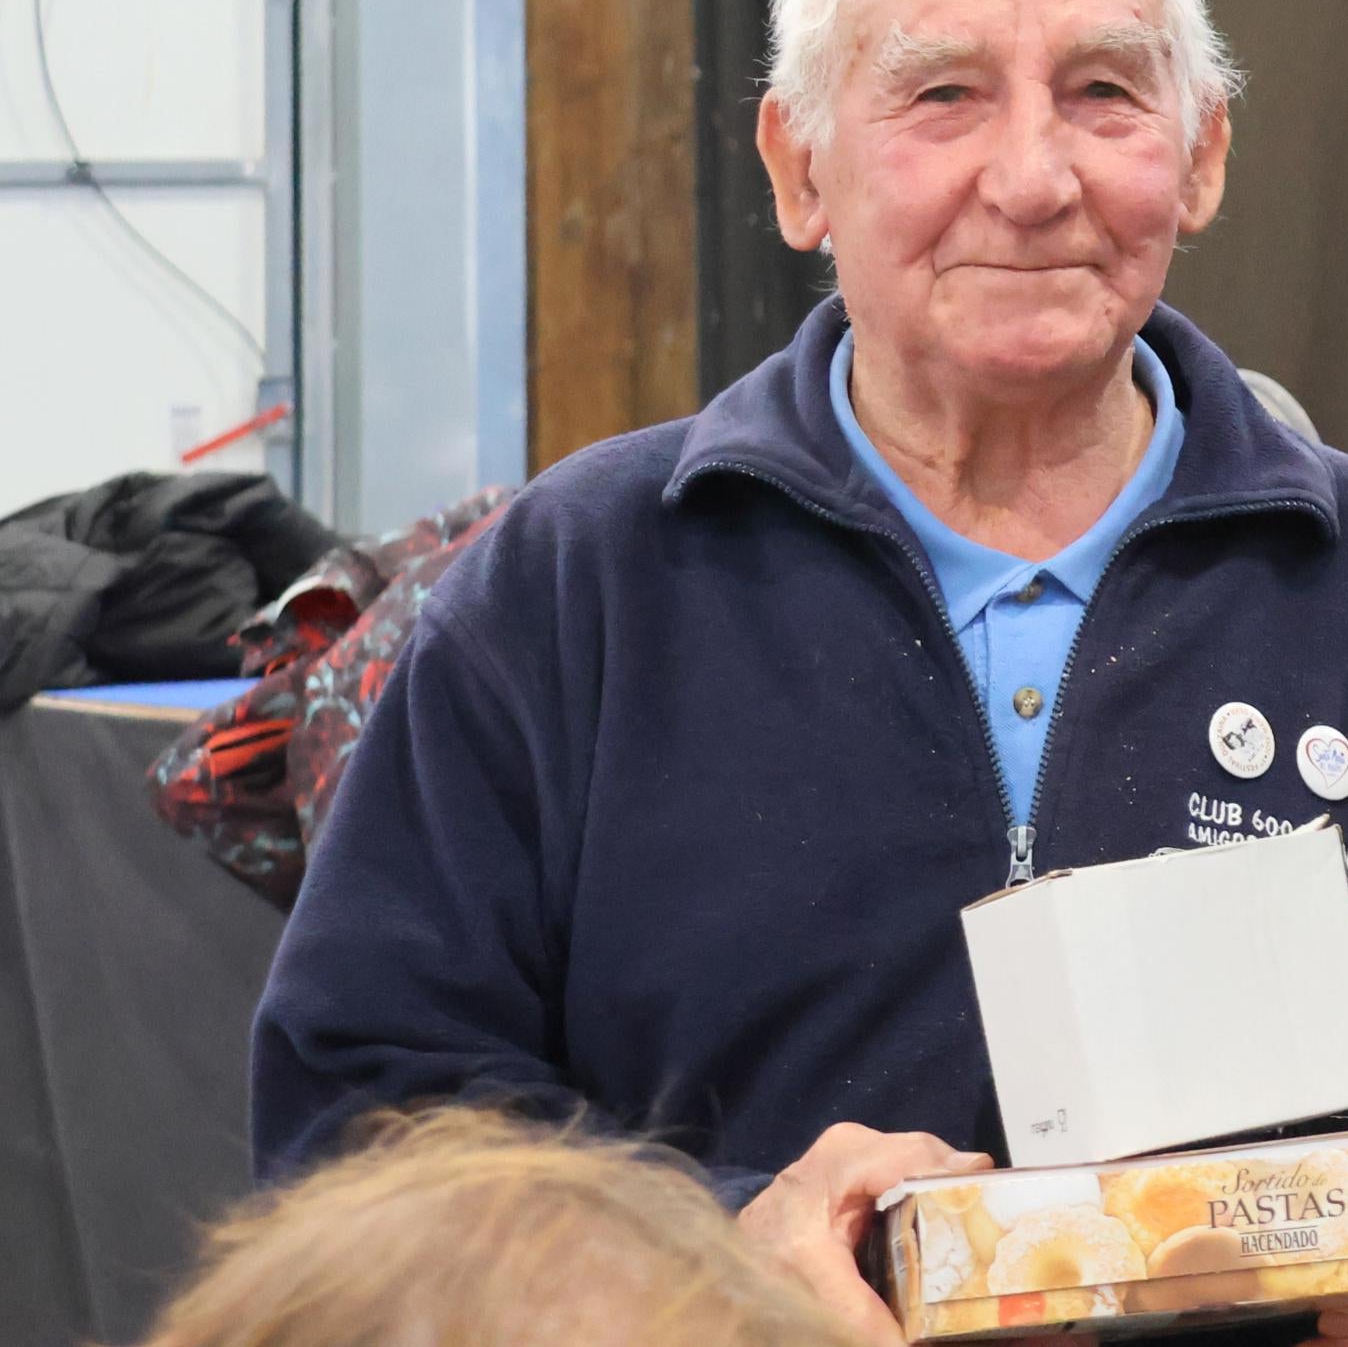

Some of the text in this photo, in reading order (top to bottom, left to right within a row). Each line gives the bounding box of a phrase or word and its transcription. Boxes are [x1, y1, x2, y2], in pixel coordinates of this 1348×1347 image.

[1188, 792, 1242, 826] CLUB
[1251, 810, 1293, 836] 600
[1222, 1164, 1308, 1195] Sortido
[1207, 1187, 1346, 1229] PASTAS
[1241, 1229, 1319, 1253] HACENDADO
